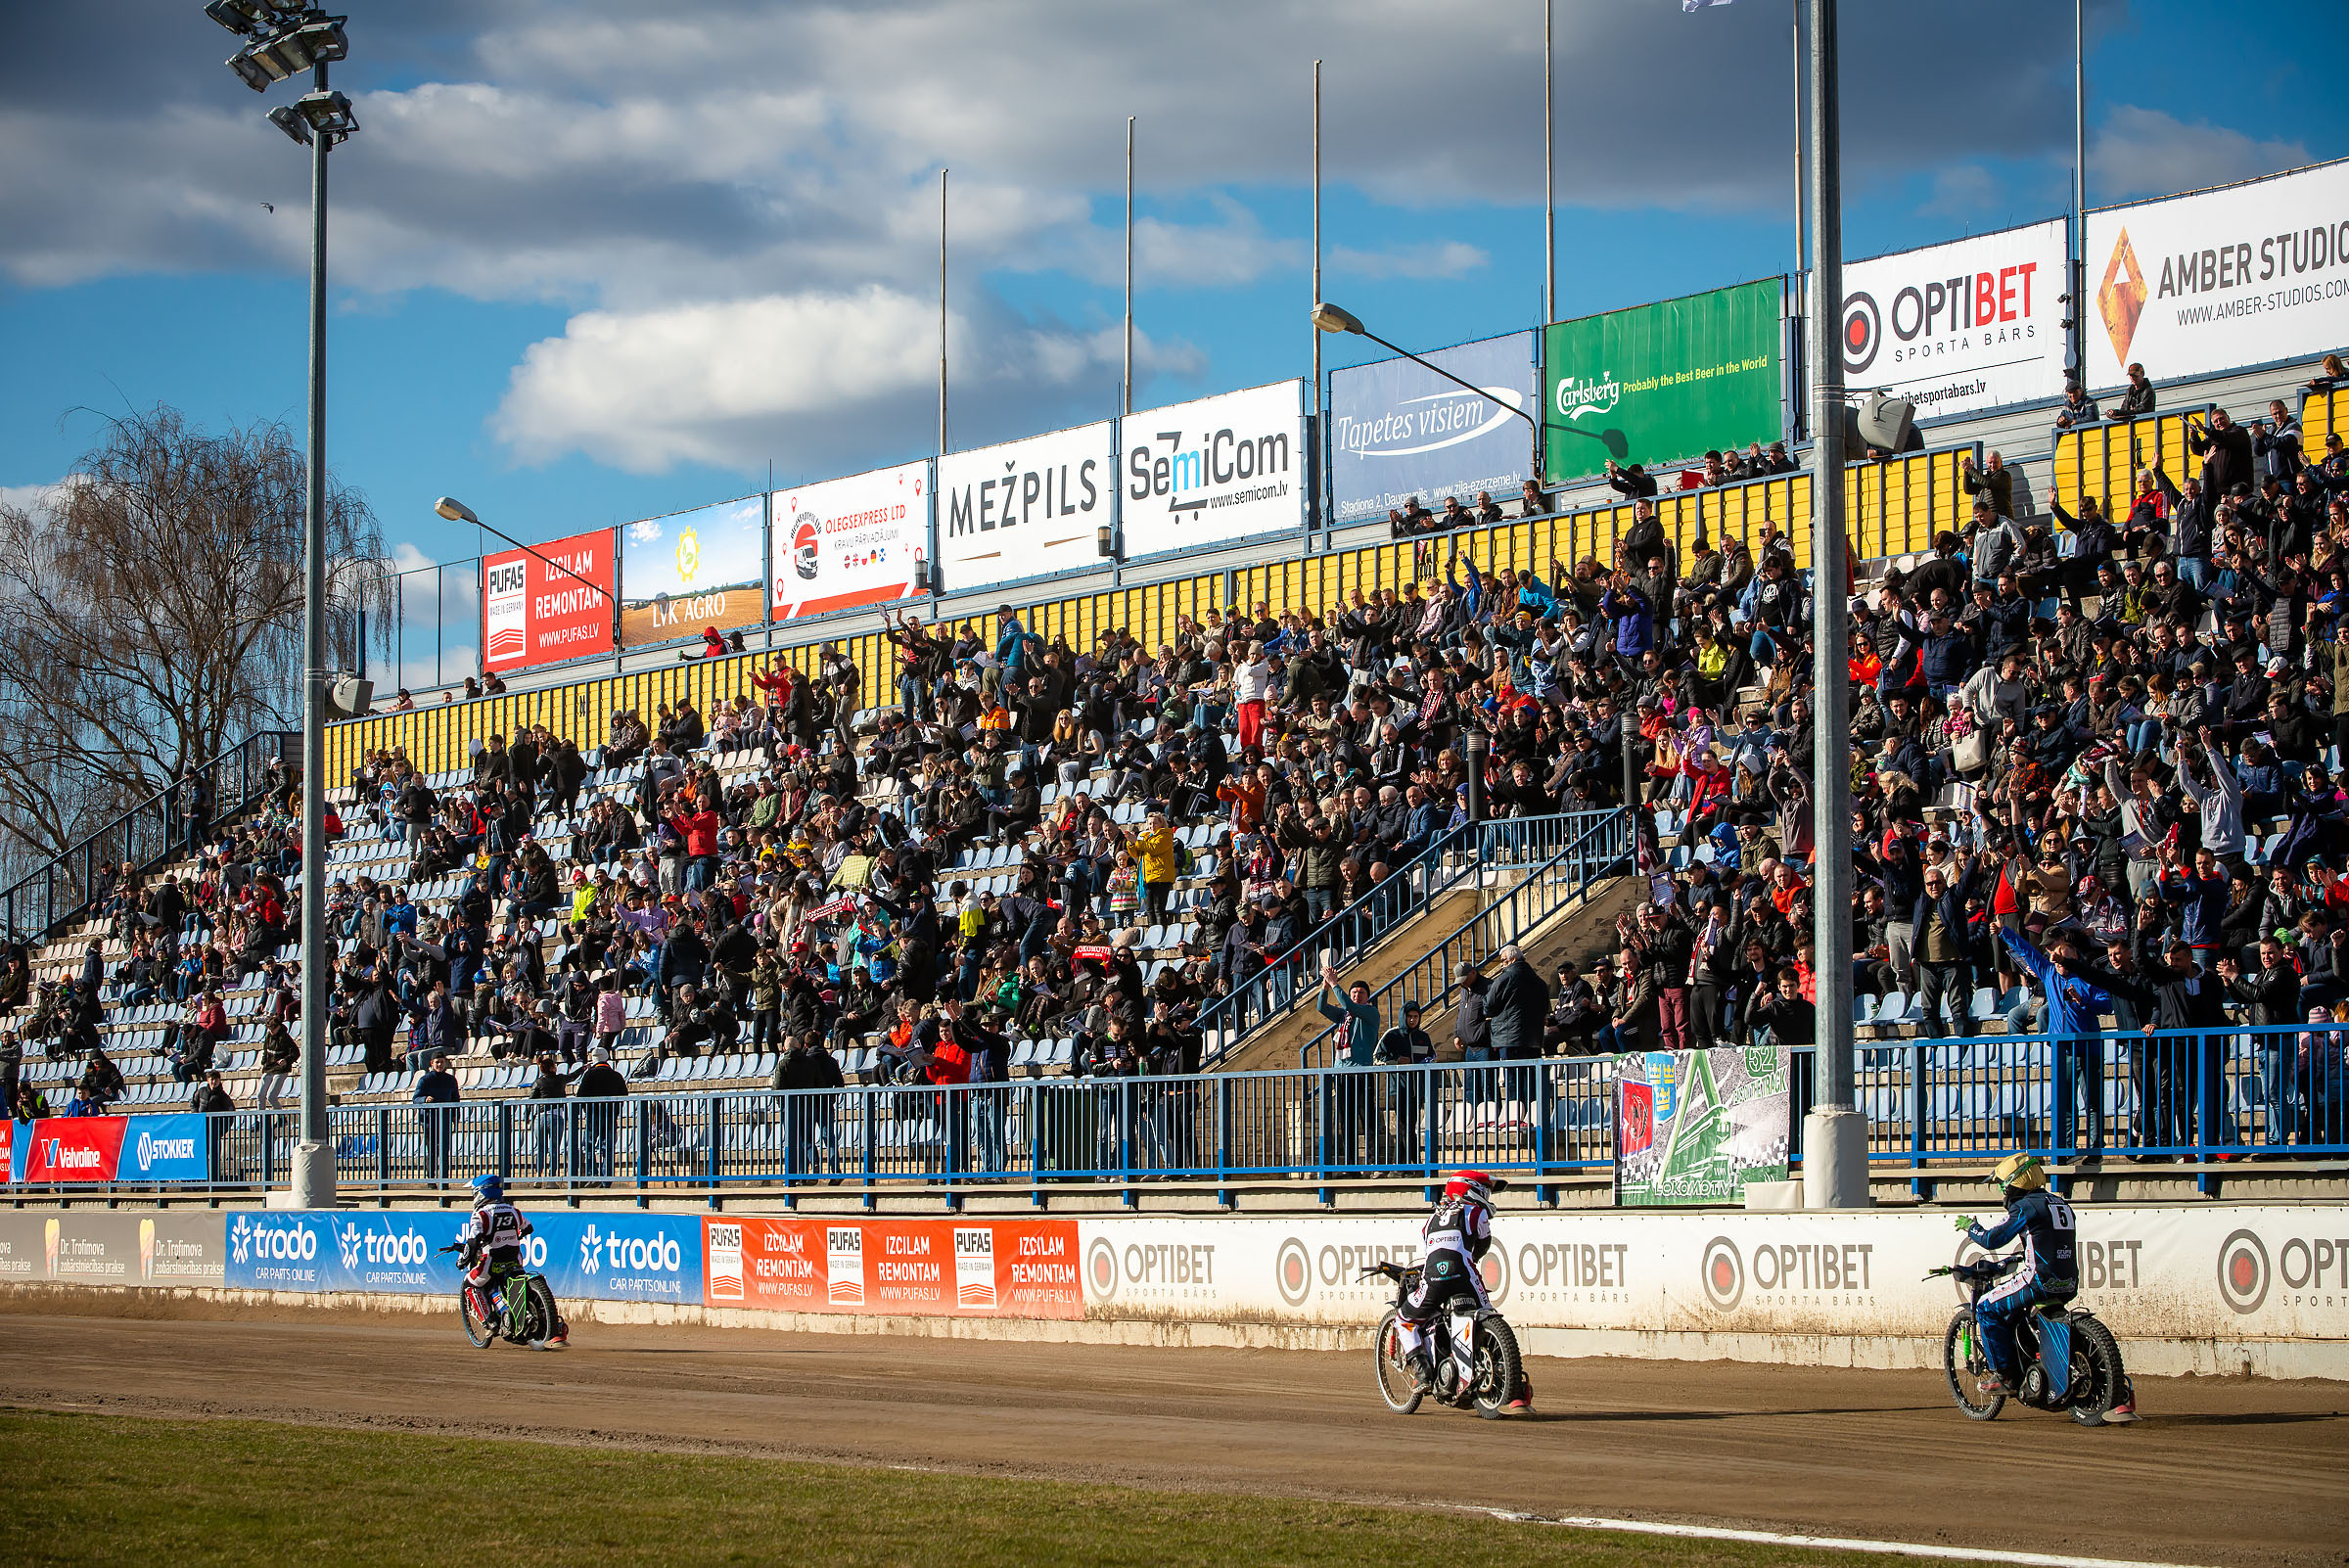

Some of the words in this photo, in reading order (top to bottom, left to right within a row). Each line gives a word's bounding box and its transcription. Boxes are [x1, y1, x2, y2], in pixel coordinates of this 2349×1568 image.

[2157, 242, 2252, 299] AMBER
[1891, 261, 2037, 342] OPTIBET
[1895, 337, 1969, 363] SPORTA
[1984, 325, 2035, 346] BĀRS
[1623, 376, 1659, 393] Probably
[1660, 374, 1674, 387] the
[1676, 369, 1693, 385] Best
[1695, 366, 1715, 381] Beer
[1716, 363, 1725, 376] in
[1726, 361, 1740, 374] the
[1741, 354, 1768, 370] World
[1556, 376, 1620, 416] Carlsberg
[1898, 378, 1986, 406] tibetsportabars.lv
[1338, 411, 1414, 461] Tapetes
[1419, 399, 1484, 436] visiem
[1129, 428, 1289, 500] SemiCom
[949, 459, 1096, 537] MEŽPILS
[1210, 480, 1288, 509] www.semicom.lv
[1341, 496, 1374, 515] Stadiona
[1375, 493, 1384, 511] 2,
[1433, 471, 1521, 500] www.zila-ezerzeme.lv
[825, 507, 888, 534] OLEGSEXPRESS
[891, 504, 906, 521] LTD
[834, 537, 853, 550] KRAVU
[545, 549, 593, 582] IZCILAM
[489, 565, 524, 595] PUFAS
[535, 583, 603, 620] REMONTAM
[652, 600, 679, 628] LVK
[683, 592, 726, 623] AGRO
[538, 623, 600, 648] WWW.PUFAS.LV
[1748, 1045, 1774, 1073] 52
[1762, 1067, 1788, 1097] TRACK
[59, 1146, 101, 1169] Valvoline
[152, 1137, 196, 1161] STOKKER
[1655, 1179, 1732, 1197] LOKOMOTIV
[496, 1216, 513, 1226] 13
[2056, 1205, 2069, 1227] 5
[60, 1239, 70, 1256] Dr.
[71, 1238, 105, 1256] Trofimova
[156, 1239, 166, 1256] Dr.
[167, 1239, 203, 1257] Trofimova
[253, 1221, 317, 1261] trodo
[364, 1226, 428, 1266] trodo
[711, 1227, 741, 1248] PUFAS
[763, 1233, 804, 1253] IZCILAM
[829, 1231, 860, 1252] PUFAS
[886, 1236, 930, 1255] IZCILAM
[956, 1232, 990, 1253] PUFAS
[1019, 1236, 1065, 1256] IZCILAM
[605, 1230, 681, 1271] trodo
[12, 1261, 31, 1272] prakse
[60, 1260, 105, 1274] zobārstniecības
[105, 1262, 125, 1275] prakse
[155, 1260, 203, 1275] zobārstniecības
[203, 1263, 225, 1276] prakse
[756, 1259, 813, 1278] REMONTAM
[878, 1263, 941, 1282] REMONTAM
[1011, 1264, 1076, 1284] REMONTAM
[1124, 1243, 1215, 1284] OPTIBET
[1518, 1242, 1628, 1287] OPTIBET
[1753, 1243, 1873, 1290] OPTIBET
[2077, 1239, 2142, 1289] IBET
[255, 1267, 269, 1281] CAR
[269, 1268, 291, 1282] PARTS
[292, 1268, 315, 1282] ONLINE
[366, 1271, 380, 1284] CAR
[381, 1271, 401, 1284] PARTS
[401, 1272, 427, 1285] ONLINE
[610, 1277, 626, 1292] CAR
[627, 1278, 653, 1293] PARTS
[653, 1279, 681, 1294] ONLINE
[758, 1282, 813, 1298] WWW.PUFAS.LV
[880, 1286, 941, 1301] WWW.PUFAS.LV
[1012, 1287, 1077, 1304] WWW.PUFAS.LV
[1126, 1287, 1174, 1298] SPORTA
[1183, 1286, 1217, 1299] BĀRS
[1319, 1291, 1375, 1301] SPORTA
[1519, 1291, 1579, 1303] SPORTA
[1589, 1290, 1629, 1304] BĀRS
[1755, 1295, 1821, 1306] SPORTA
[1832, 1293, 1875, 1307] BĀRS
[2097, 1292, 2144, 1307] BĀRS
[2282, 1295, 2348, 1307] SPORT
